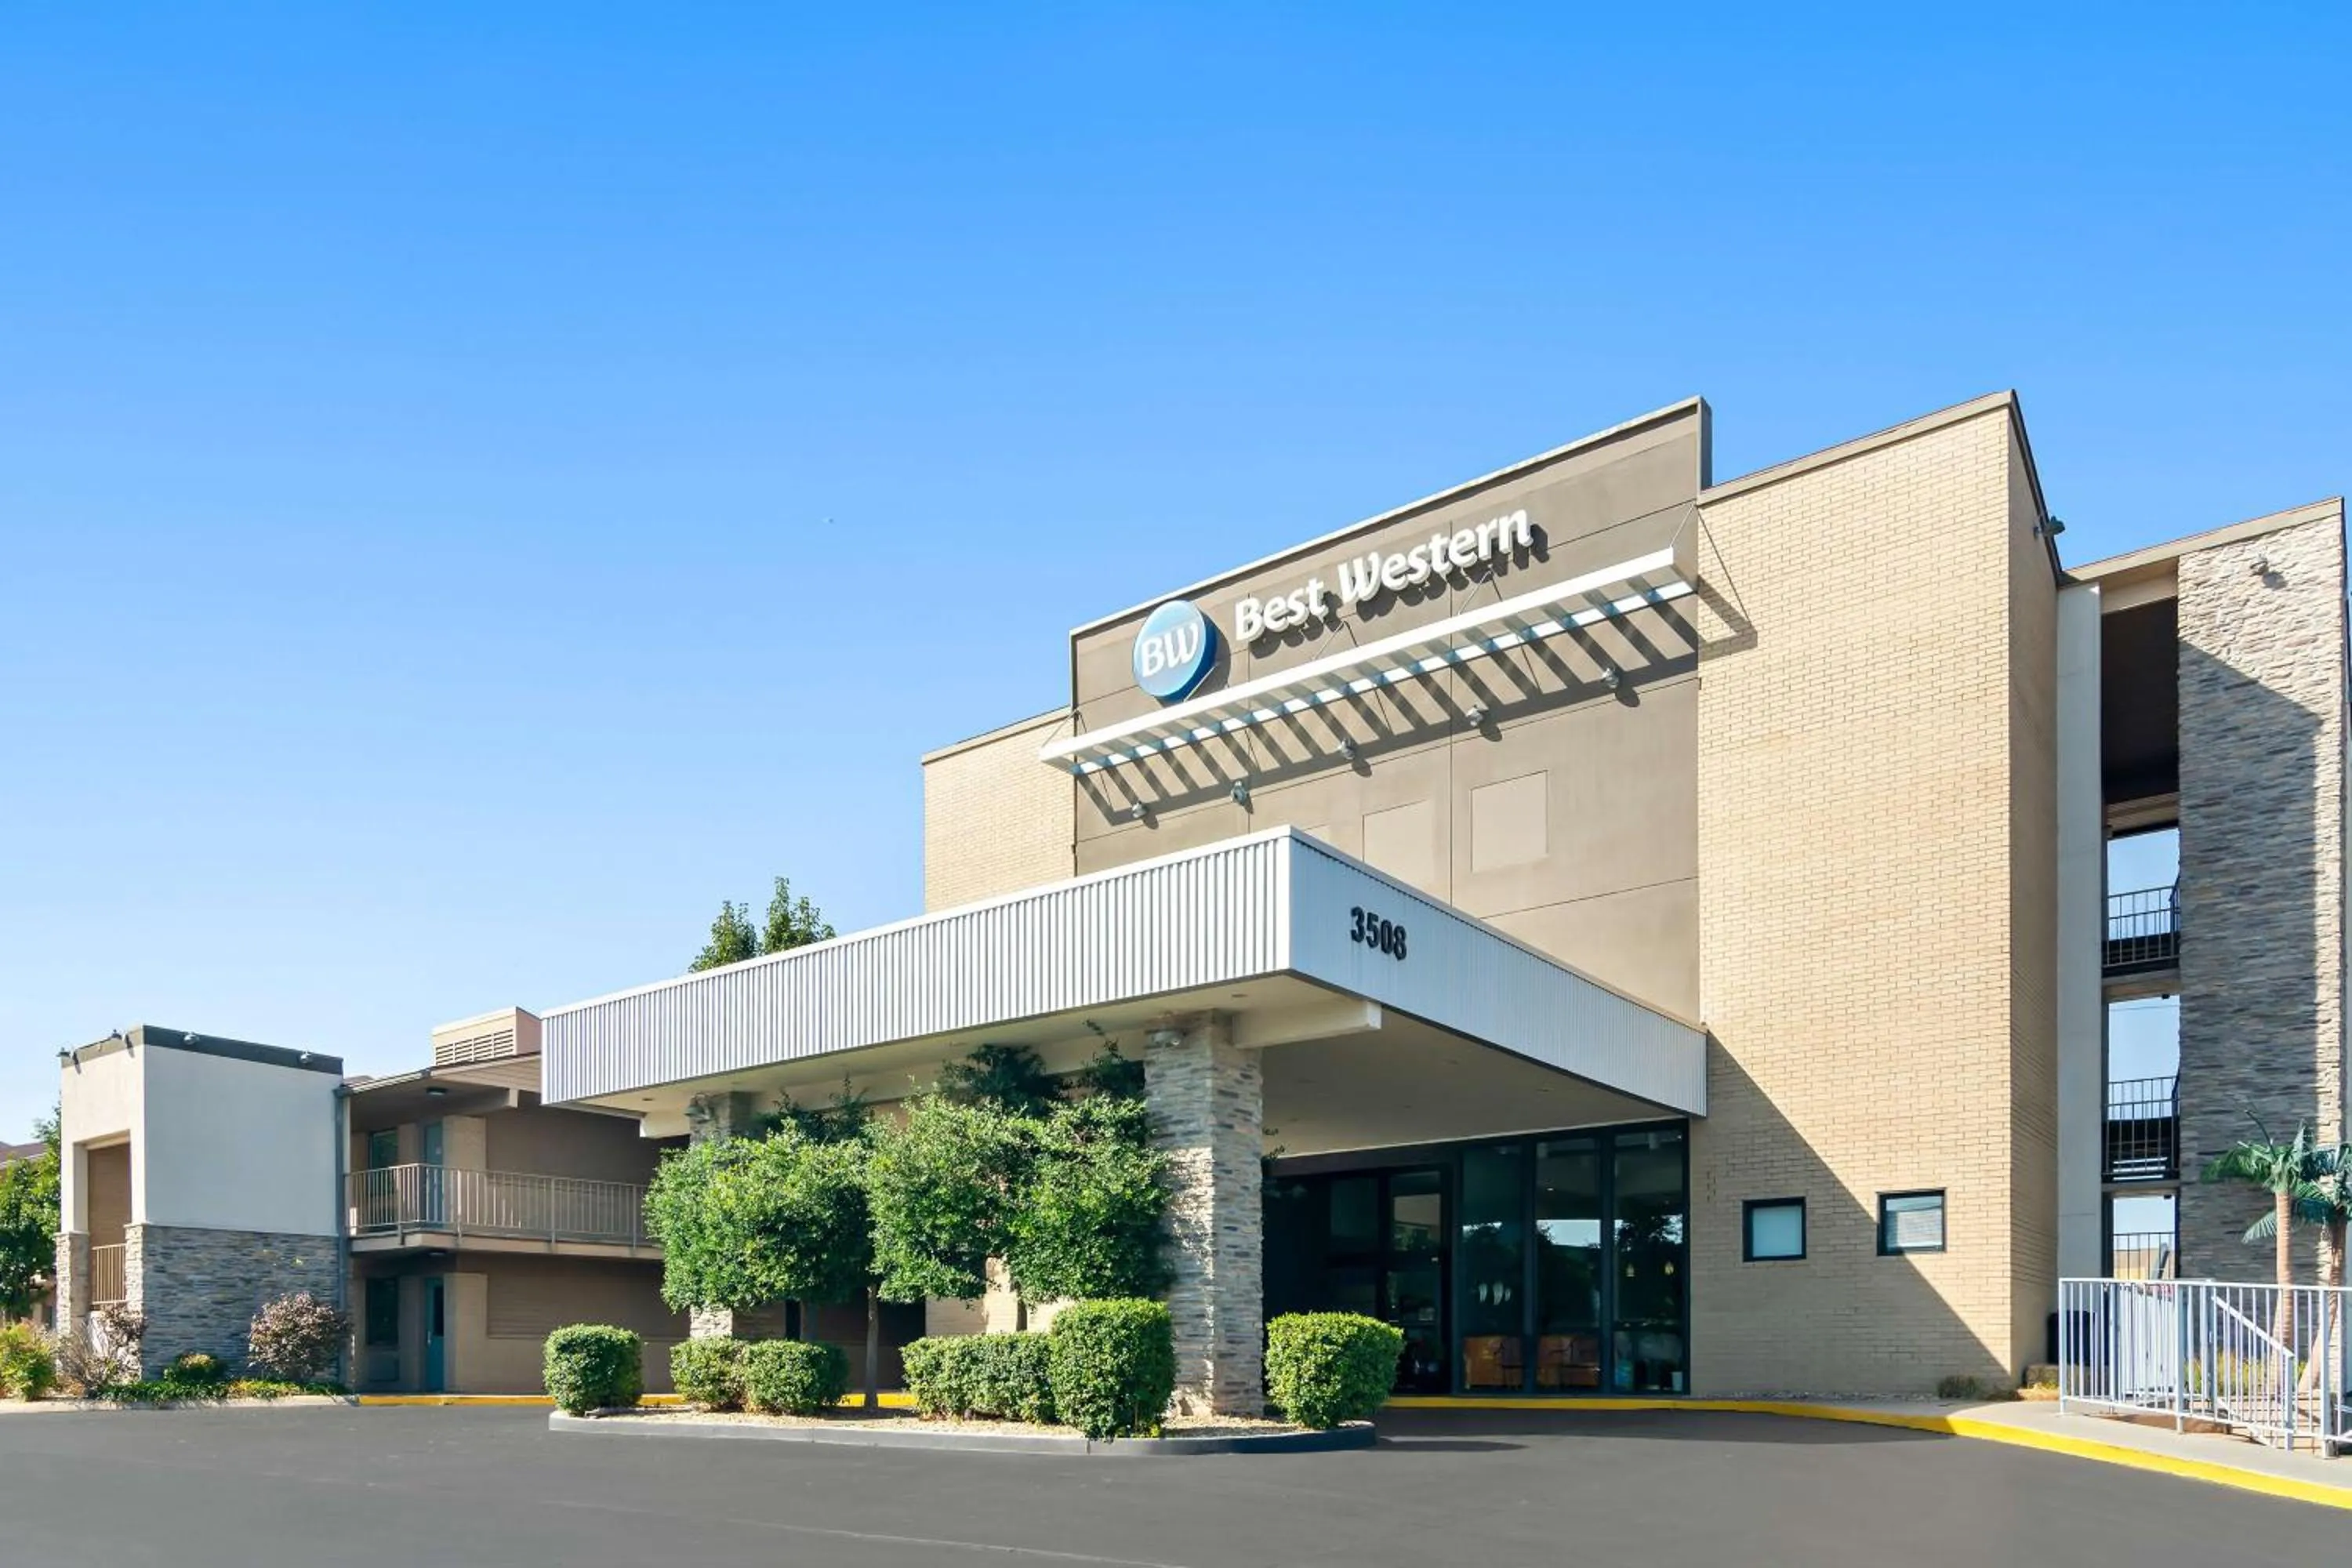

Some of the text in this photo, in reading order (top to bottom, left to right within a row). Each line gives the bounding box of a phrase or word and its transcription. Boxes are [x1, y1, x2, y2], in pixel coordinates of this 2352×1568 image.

[1236, 509, 1534, 644] Best Western
[1141, 621, 1200, 677] BW
[1350, 906, 1408, 960] 3508
